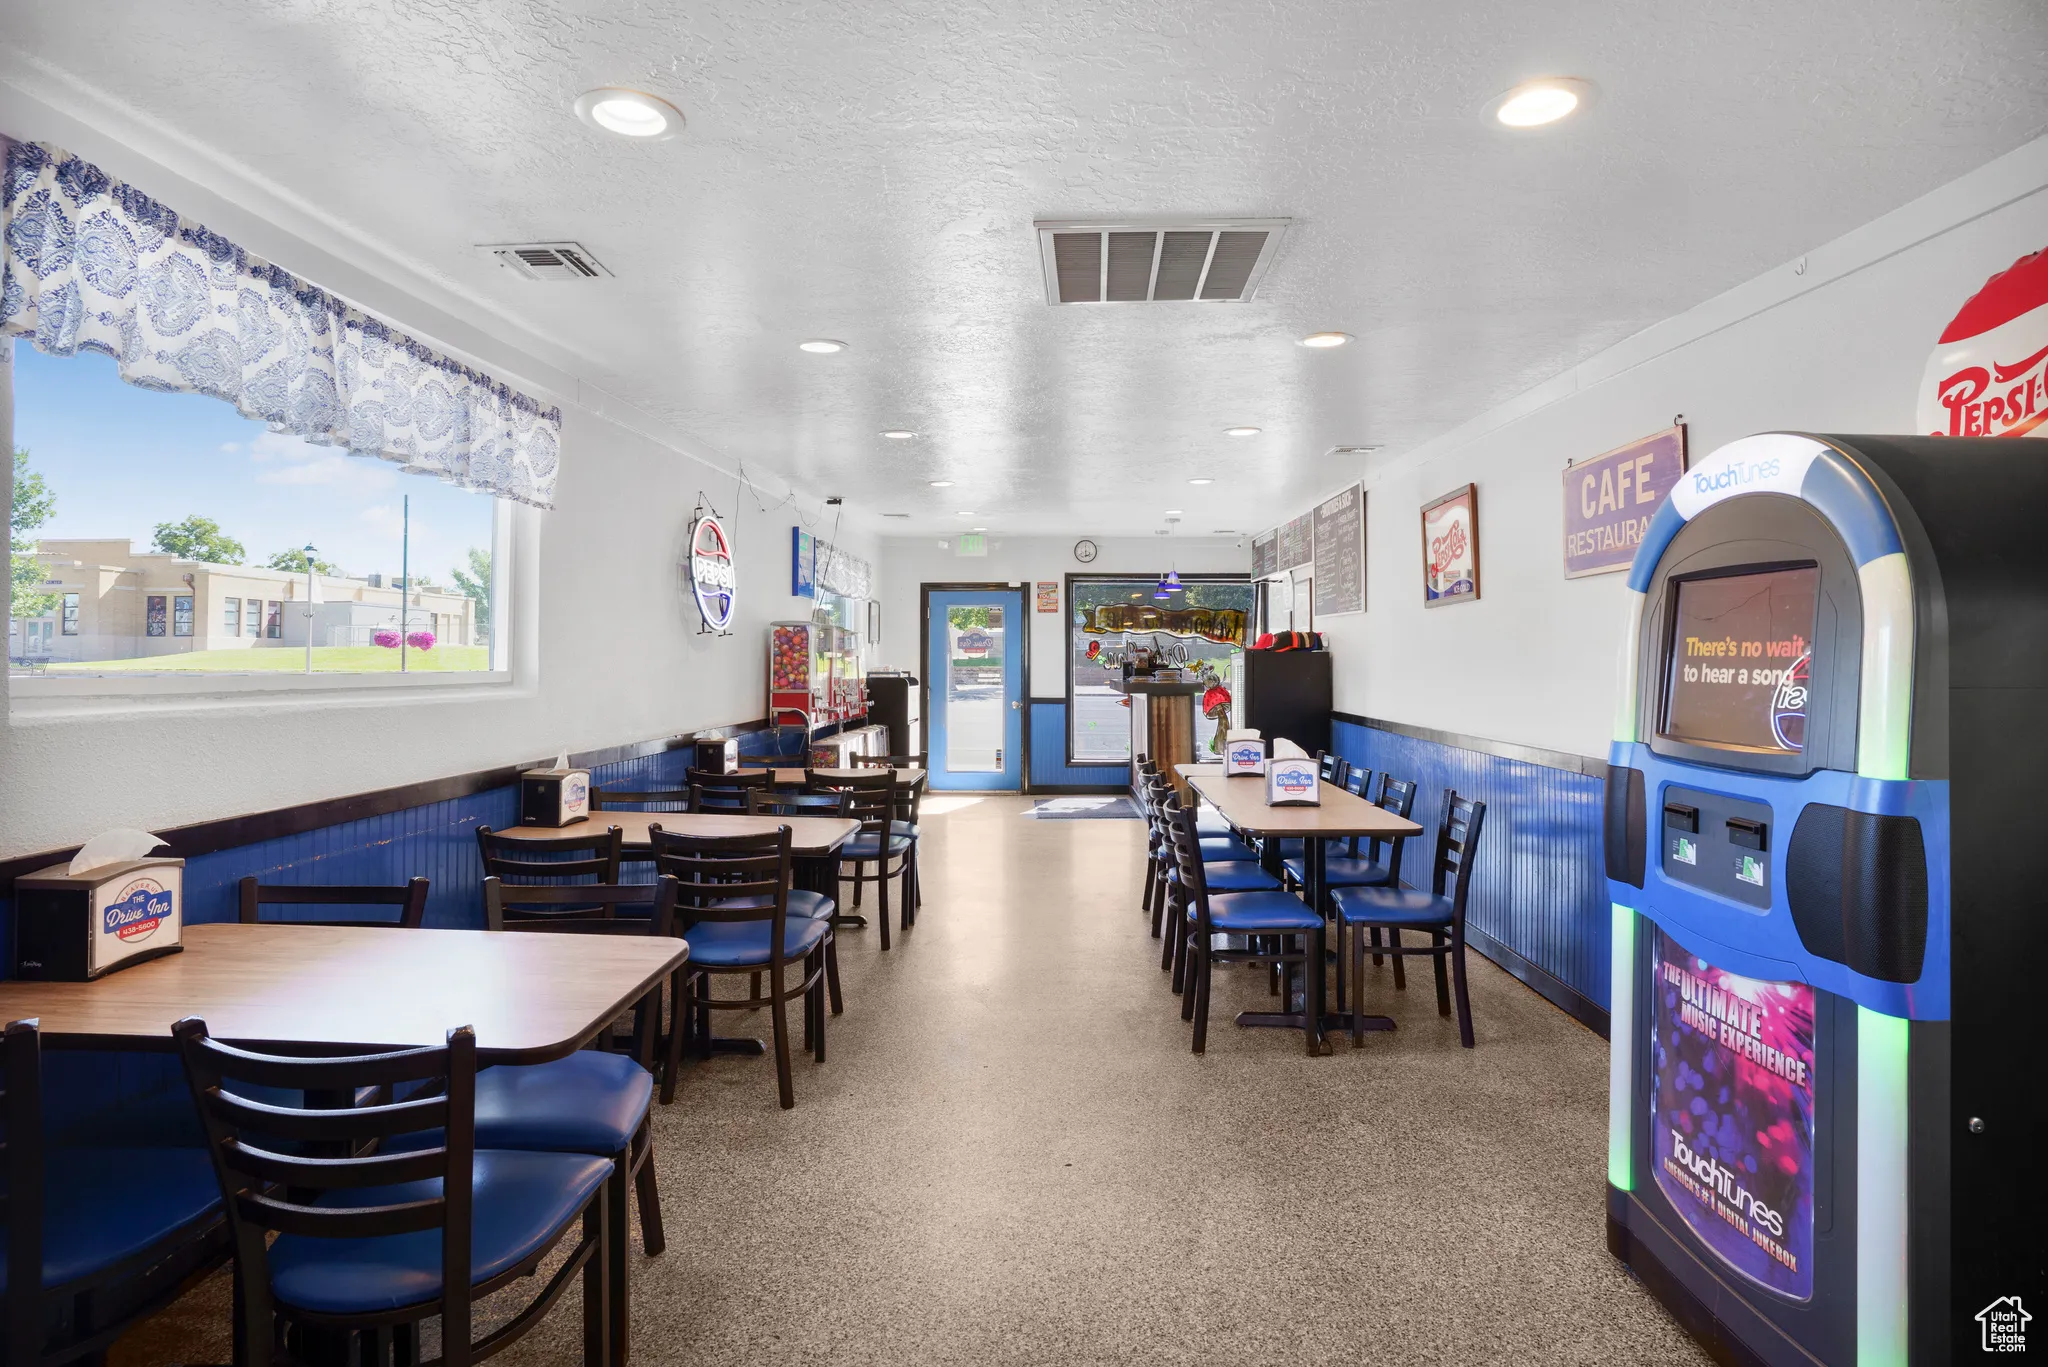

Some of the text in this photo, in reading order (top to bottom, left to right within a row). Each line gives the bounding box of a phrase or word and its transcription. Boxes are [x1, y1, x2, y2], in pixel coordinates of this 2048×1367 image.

[1581, 453, 1655, 519] CAFE
[1693, 458, 1780, 494] TouchTunes
[1567, 515, 1655, 558] RESTAURA
[696, 557, 732, 588] PEPSI
[1686, 634, 1805, 658] There's no wait
[1684, 663, 1795, 688] to hear a song
[1277, 775, 1313, 785] Drive Inn
[106, 898, 170, 927] Drive Inn
[132, 894, 145, 904] THE
[122, 920, 156, 935] 438-5600
[1664, 961, 1762, 1041] THE ULTIMATE
[1681, 1000, 1806, 1087] MUSIC EXPERIENCE
[1671, 1129, 1784, 1237] TouchTunes
[1664, 1157, 1798, 1273] AMERICA'S #1 DIGITAL JUKEBOX
